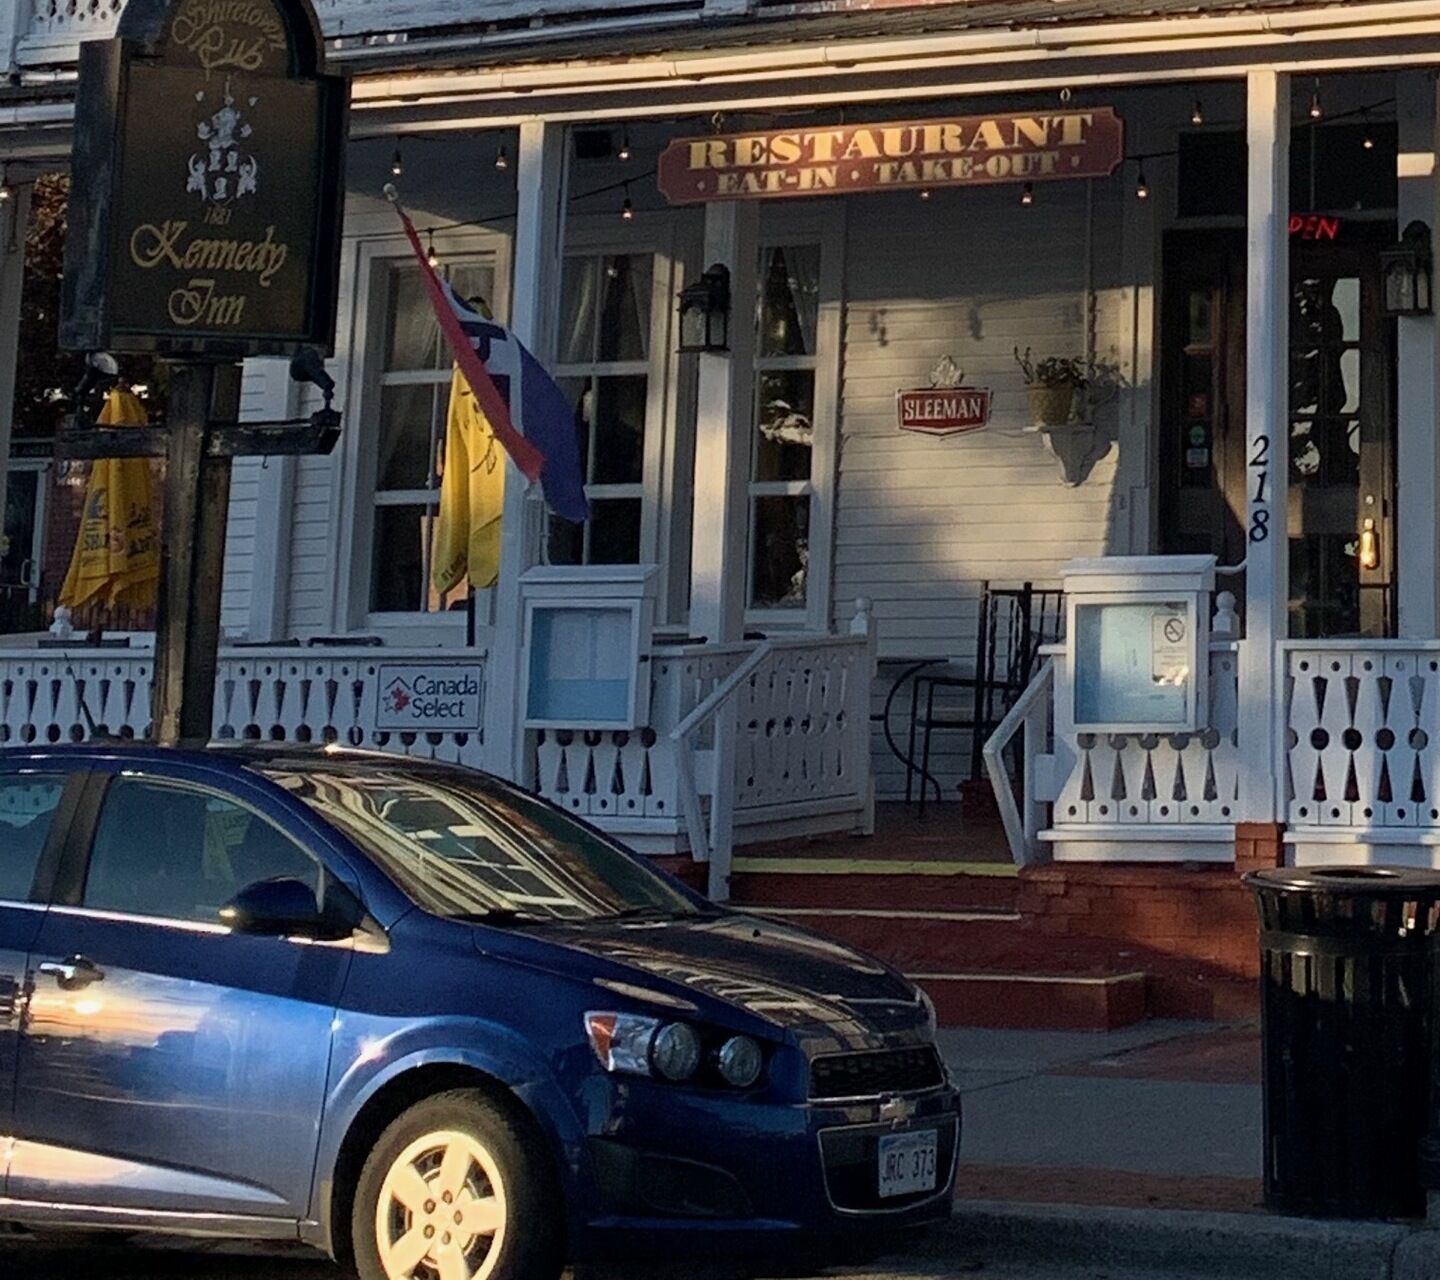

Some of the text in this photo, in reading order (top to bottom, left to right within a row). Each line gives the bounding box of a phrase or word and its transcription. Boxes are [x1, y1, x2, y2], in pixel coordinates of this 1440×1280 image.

[687, 113, 1093, 170] RESTAURANT
[717, 151, 1060, 194] EAT-IN TAKE-OUT
[1288, 216, 1339, 240] PEN
[130, 219, 288, 287] Kennedy
[168, 278, 246, 325] Inn
[903, 398, 982, 421] SLEEMAN
[1248, 434, 1270, 542] 218
[412, 674, 478, 695] Canada
[411, 697, 465, 718] Select
